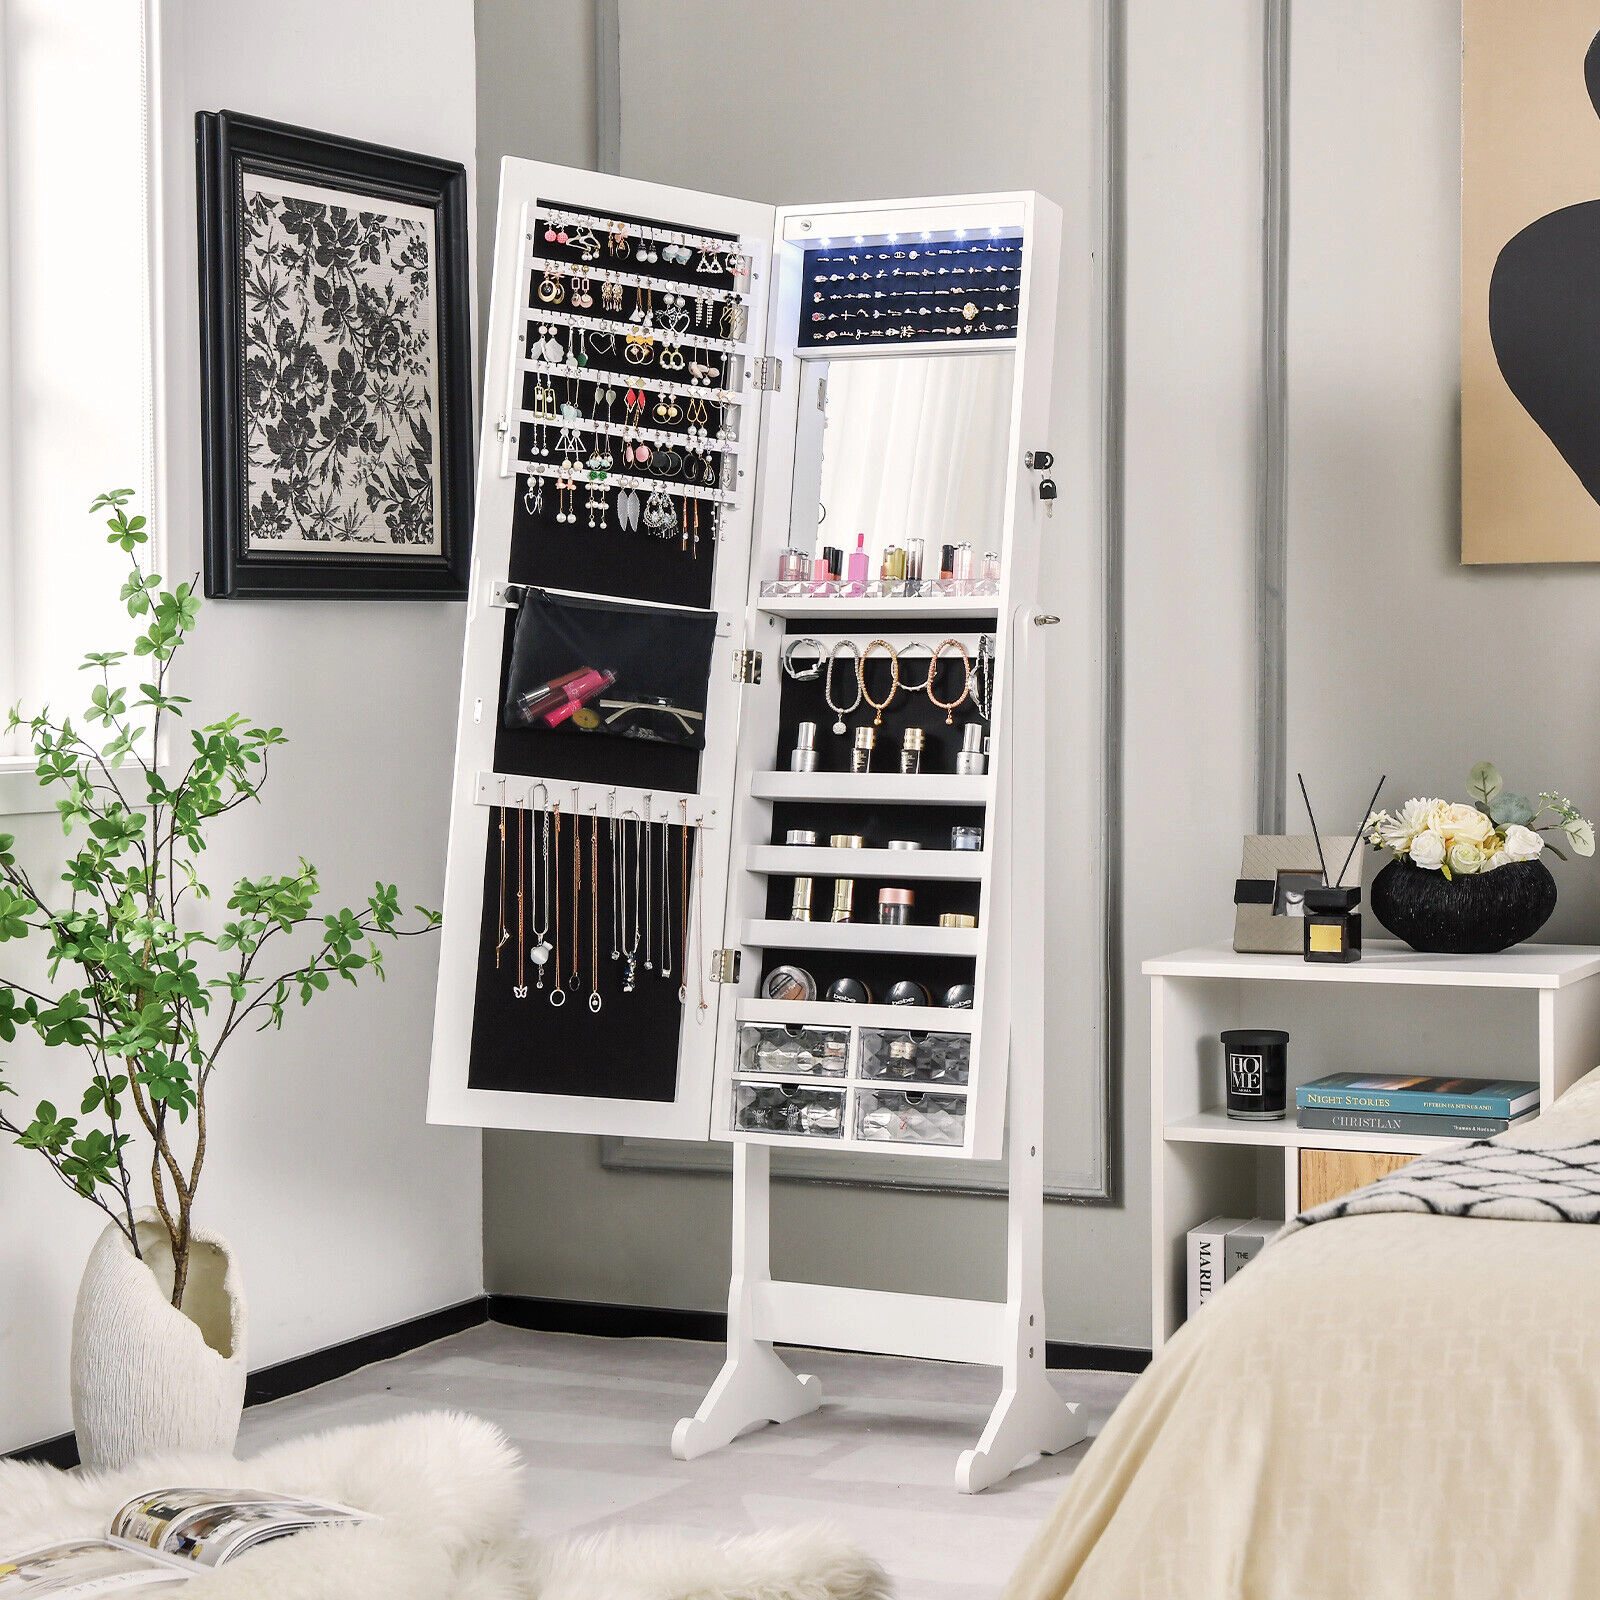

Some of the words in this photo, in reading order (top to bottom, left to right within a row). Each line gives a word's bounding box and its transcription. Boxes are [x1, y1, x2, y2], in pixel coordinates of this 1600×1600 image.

[1307, 1094, 1343, 1105] NIGHT
[1345, 1096, 1391, 1107] STORIES
[1235, 1251, 1249, 1260] THE
